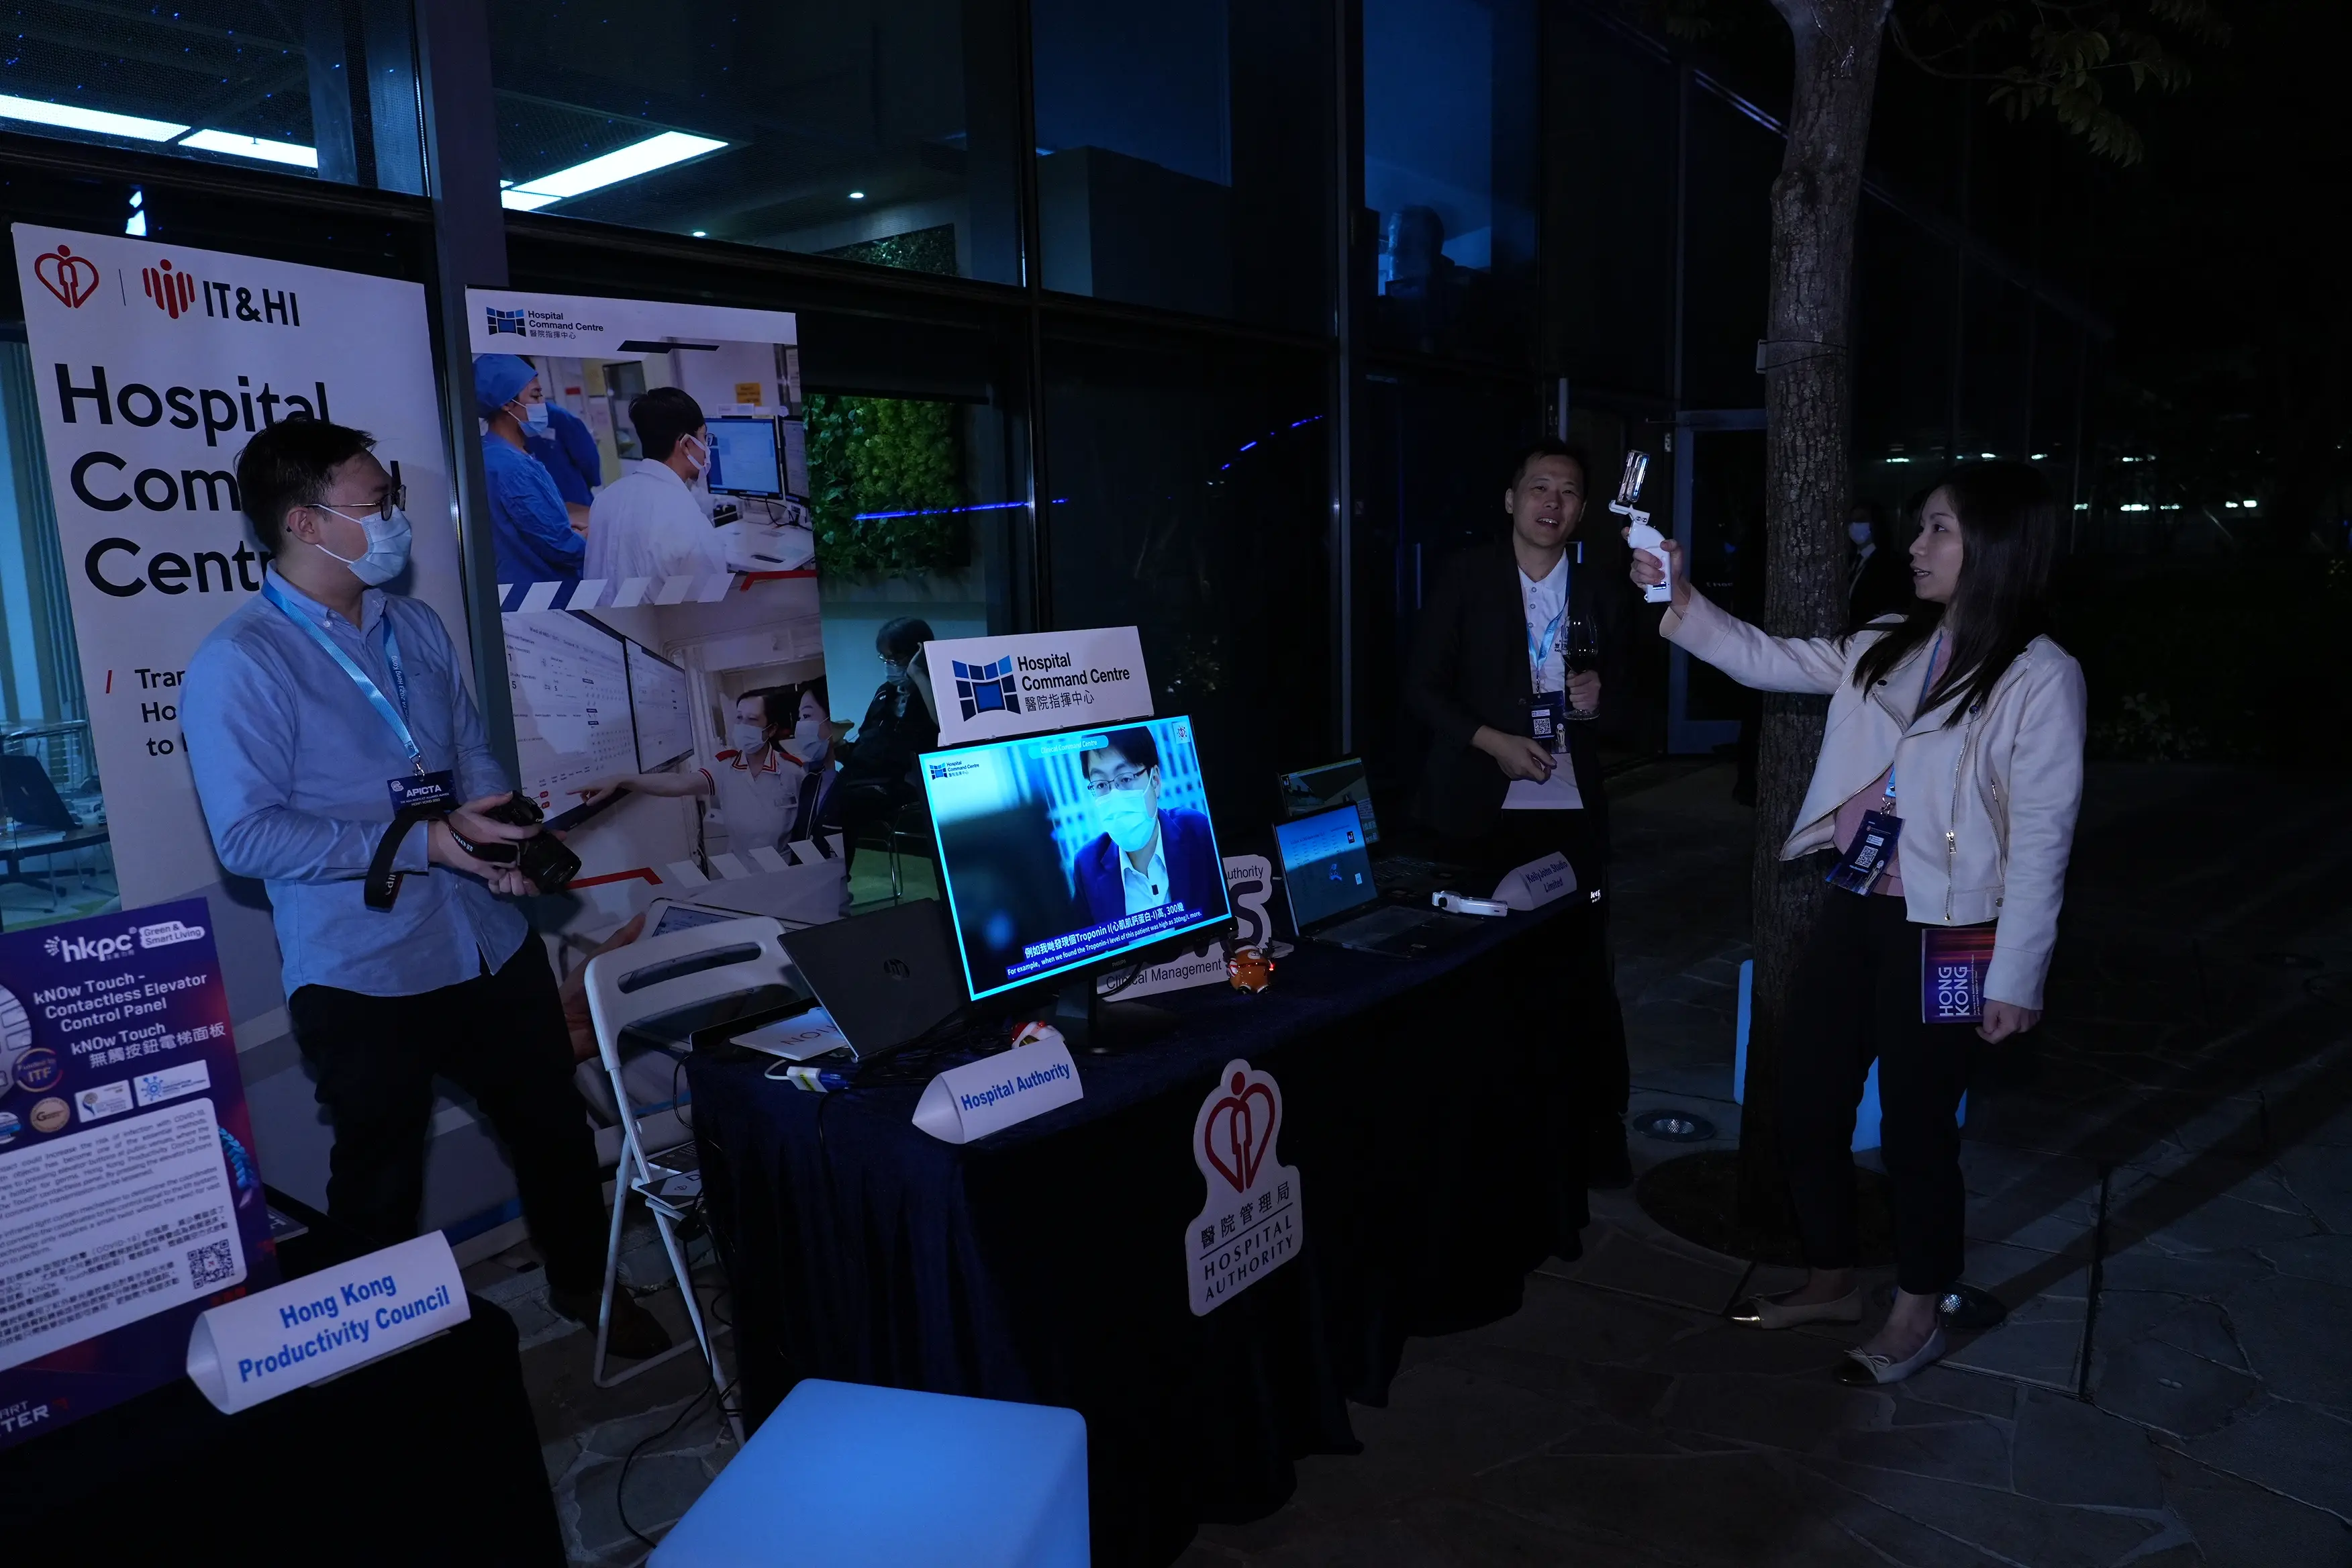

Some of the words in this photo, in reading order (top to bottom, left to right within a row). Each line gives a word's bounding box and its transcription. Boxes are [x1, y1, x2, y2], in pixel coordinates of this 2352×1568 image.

[203, 280, 300, 327] IT&HI
[528, 310, 564, 320] Hospital
[529, 320, 573, 330] Command
[575, 323, 604, 332] Centre
[54, 363, 330, 447] Hospital
[1018, 652, 1071, 672] Hospital
[1021, 670, 1087, 691] Command
[1090, 667, 1130, 684] Centre
[1024, 689, 1095, 712] 醫院指揮中心
[146, 738, 174, 756] to
[406, 784, 442, 797] APICTA
[1226, 865, 1263, 881] uthority
[1550, 860, 1568, 873] Studio
[1543, 877, 1563, 893] Limited
[144, 926, 170, 937] Green
[146, 934, 173, 946] Smart
[175, 928, 201, 940] Living
[60, 934, 134, 963] hkpc
[1008, 968, 1017, 976] For
[1017, 961, 1040, 973] example,
[1040, 956, 1055, 965] when
[1063, 948, 1077, 959] found
[1110, 935, 1121, 944] level
[1125, 930, 1135, 938] this
[1134, 926, 1150, 937] patient
[1159, 920, 1169, 929] high
[1150, 958, 1222, 982] Management
[85, 973, 134, 993] Touch
[1938, 967, 1954, 1016] HONG
[1954, 967, 1970, 1016] KONG
[45, 989, 142, 1020] Contactless
[144, 974, 207, 997] Elevator
[60, 1008, 121, 1032] Control
[123, 997, 167, 1018] Panel
[119, 1022, 166, 1042] Touch
[961, 1079, 1015, 1111] Hospital
[1016, 1063, 1070, 1092] Authority
[1201, 1181, 1290, 1250] 醫院管理局
[1204, 1214, 1293, 1280] HOSPITAL
[1206, 1234, 1293, 1302] AUTHORITY
[279, 1295, 338, 1328] Hong
[340, 1275, 397, 1306] Kong
[238, 1319, 369, 1383] Productivity
[375, 1284, 450, 1329] Council
